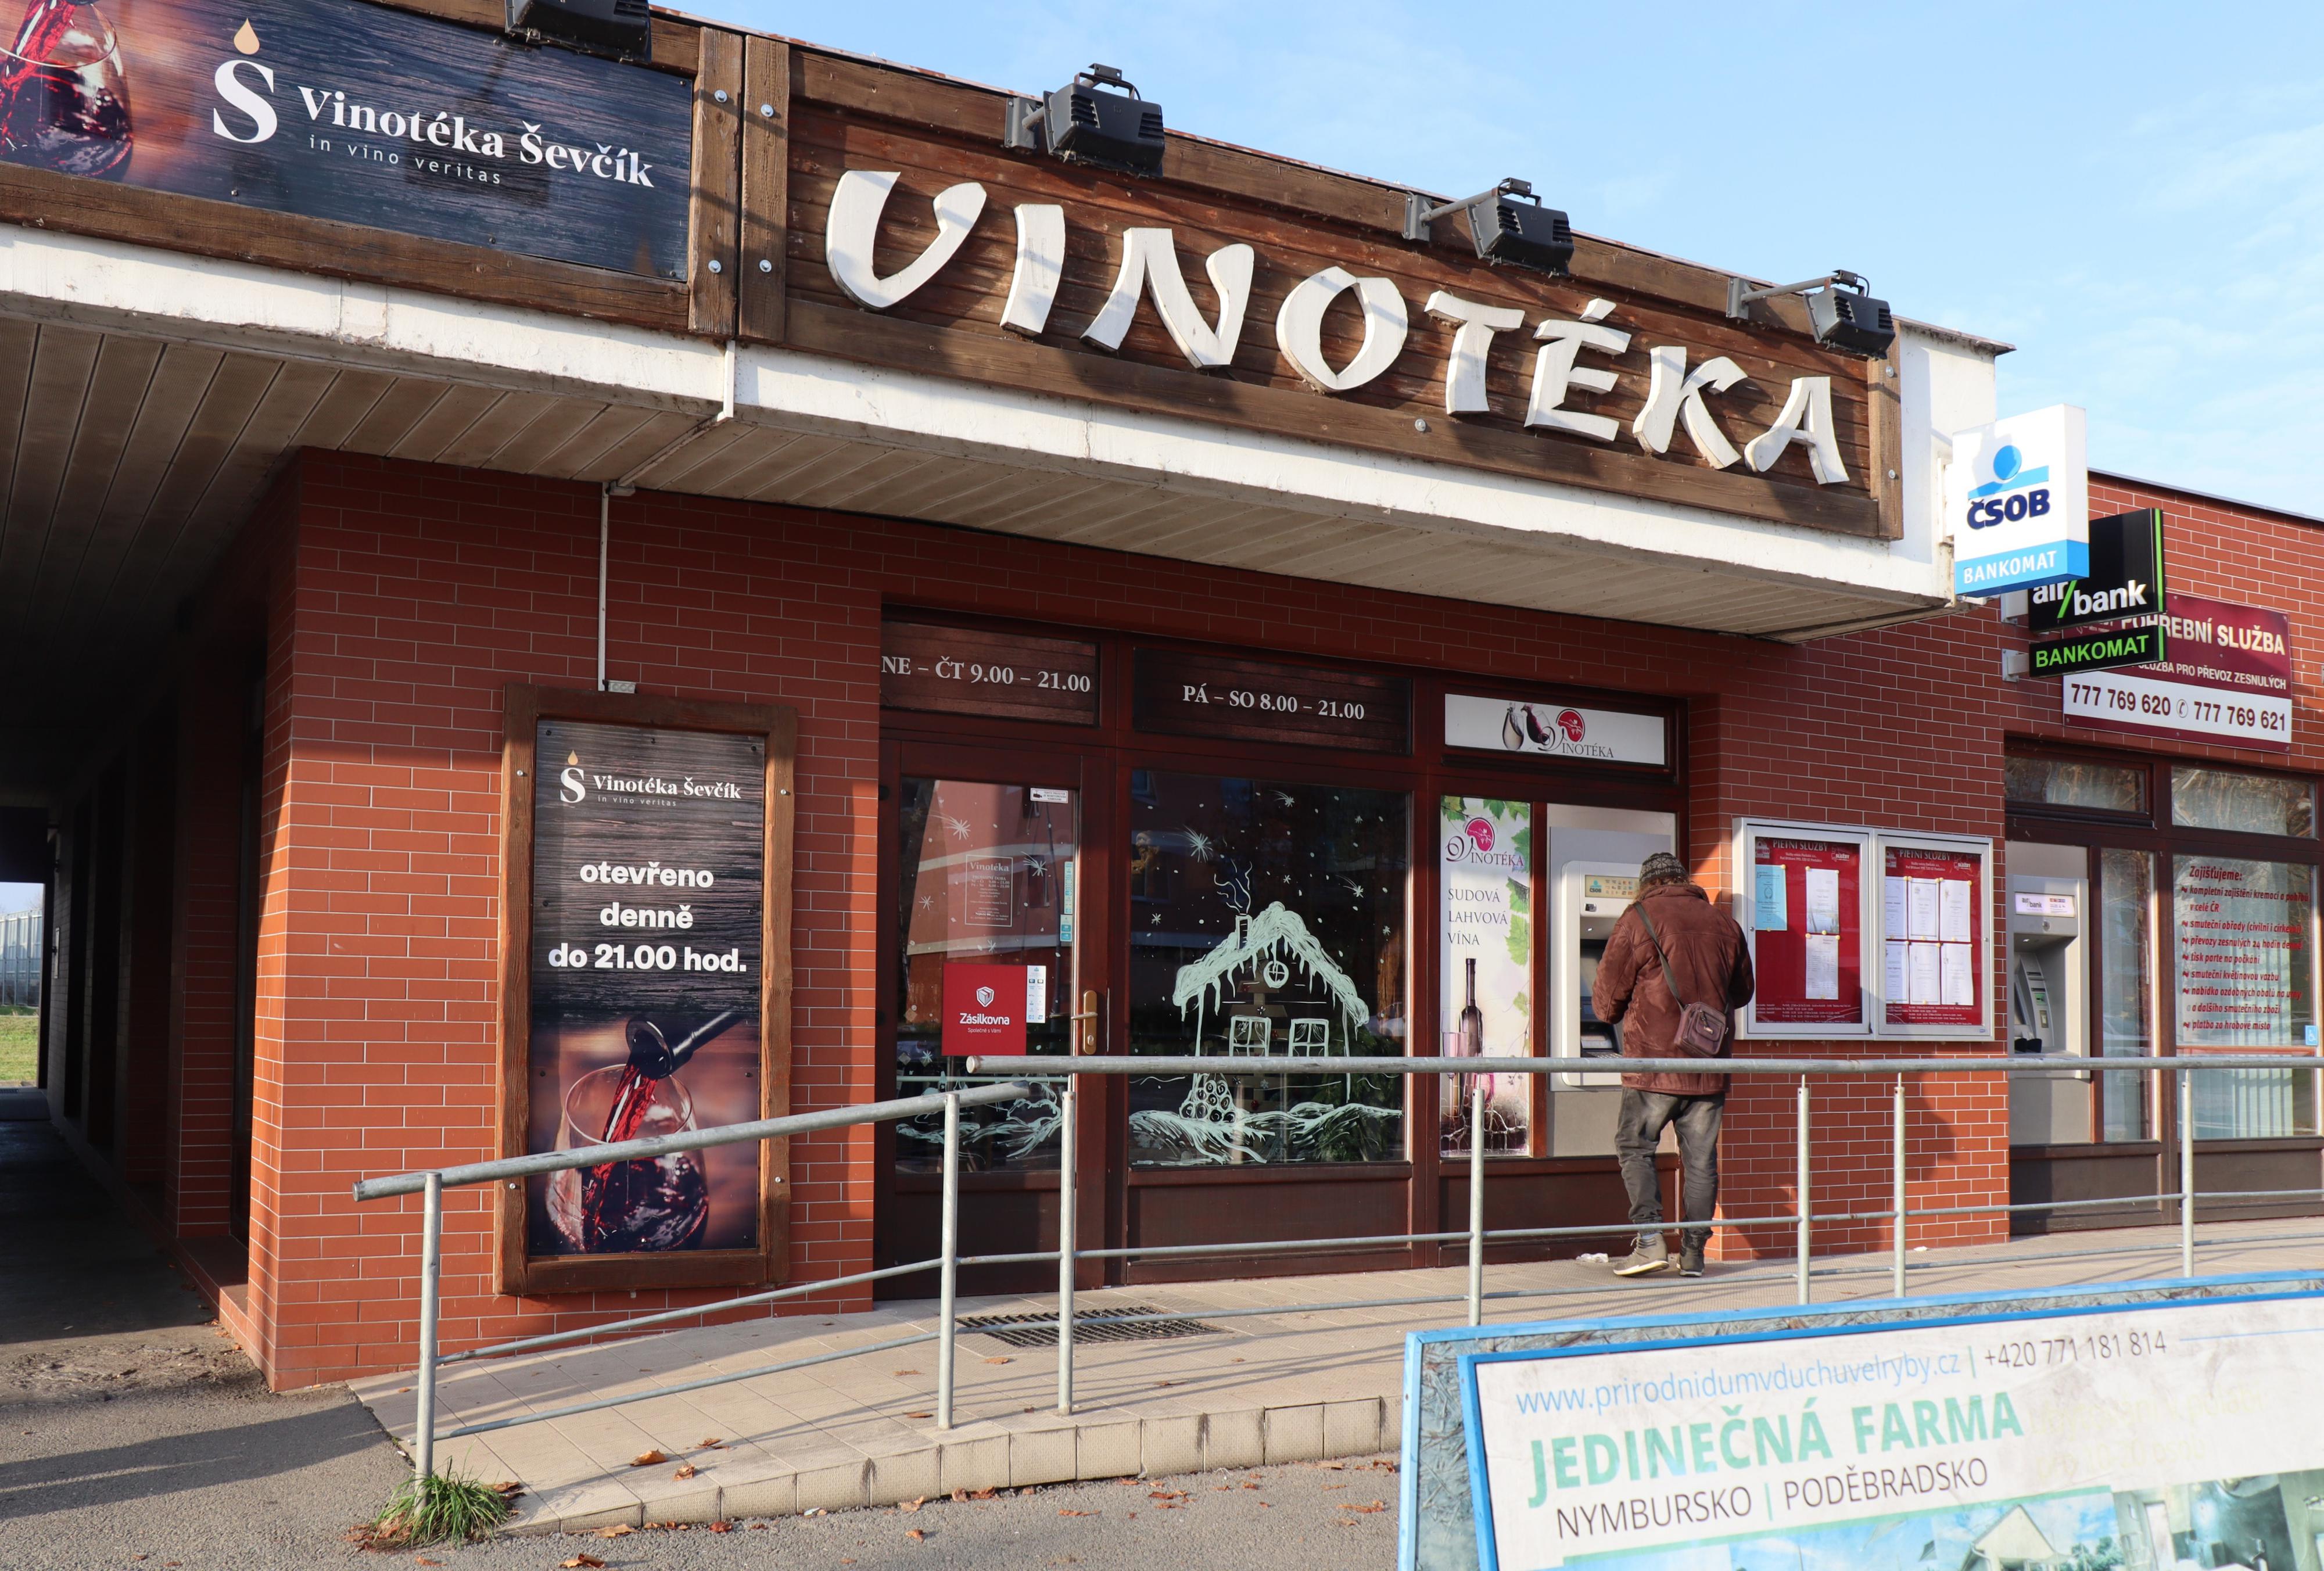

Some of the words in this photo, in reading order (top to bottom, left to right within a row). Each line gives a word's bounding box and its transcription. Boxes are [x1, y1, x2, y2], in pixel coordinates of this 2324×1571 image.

[297, 86, 505, 159] Vinotéka
[520, 120, 654, 188] Ševčík
[309, 134, 331, 152] in
[348, 144, 399, 165] vino
[415, 156, 501, 185] veritas
[825, 169, 1850, 485] VINOTÉKA
[1967, 488, 2050, 530] ČSOB
[1964, 550, 2057, 584] BANKOMAT
[2036, 635, 2149, 668] BANKOMAT
[2217, 625, 2286, 656] SLUŽBA
[881, 655, 911, 676] NE
[935, 655, 964, 680] ČT
[970, 663, 1014, 684] 9.00
[1038, 670, 1091, 693] 21.00
[2176, 663, 2195, 677] PRO
[2197, 665, 2232, 682] PŘEVOZ
[2234, 670, 2286, 690] ZESNULÝCH
[1183, 683, 1209, 704] PÁ
[1229, 690, 1254, 708] SO
[1260, 694, 1298, 713] 8.00
[1317, 700, 1365, 720] 21.00
[2071, 683, 2101, 706] 777
[2107, 688, 2136, 711] 769
[2142, 694, 2171, 716] 620
[2193, 701, 2221, 723] 777
[2226, 705, 2255, 727] 769
[2261, 711, 2286, 731] 621
[593, 774, 677, 795] Vinotéka
[683, 777, 742, 799] Ševčík
[612, 796, 635, 805] vino
[640, 798, 677, 807] veritas
[580, 861, 714, 888] otevřeno
[970, 862, 1009, 871] Vinotéka
[2189, 866, 2243, 882] Zajišťujeme:
[1448, 888, 1501, 902] SUDOVÁ
[2190, 885, 2223, 897] kompletní
[2224, 888, 2252, 899] zajištění
[2254, 889, 2279, 899] kremací
[600, 902, 694, 929] denně
[1448, 910, 1508, 925] LAHVOVÁ
[2195, 902, 2208, 911] celé
[2210, 901, 2219, 912] ČR
[1447, 930, 1480, 945] VÍNA
[2190, 919, 2221, 930] smuteční
[2222, 921, 2245, 932] obřady
[2190, 936, 2217, 948] převozy
[2218, 937, 2250, 949] zesnulých
[2253, 941, 2261, 950] 24
[2262, 939, 2280, 949] hodin
[548, 942, 587, 968] do
[594, 944, 677, 970] 21.00
[683, 946, 747, 972] hod.
[2191, 952, 2203, 962] tisk
[2205, 954, 2222, 964] parte
[2234, 953, 2261, 965] počkání
[2192, 969, 2222, 980] smuteční
[2223, 970, 2258, 980] květinovou
[2260, 971, 2279, 981] vazbu
[2192, 985, 2218, 995] nabídka
[2220, 987, 2255, 999] ozdobných
[2257, 987, 2275, 997] obalů
[959, 1013, 1010, 1025] Zásilkovna
[2198, 1002, 2222, 1012] dalšího
[2224, 1003, 2262, 1013] smutečního
[2264, 1005, 2280, 1014] zboží
[2193, 1020, 2214, 1030] platba
[2225, 1020, 2251, 1030] hrobové
[2253, 1021, 2270, 1030] místo
[1517, 1350, 1960, 1415] www.prirodnidumvduchuvelryby.cz
[1984, 1342, 2037, 1368] +420
[2041, 1337, 2079, 1365] 771
[2087, 1334, 2122, 1360] 181
[2131, 1330, 2167, 1356] 814
[1528, 1397, 1833, 1508] JEDINEČNÁ
[1851, 1392, 2024, 1454] FARMA
[1556, 1486, 1753, 1540] NYMBURSKO
[1785, 1457, 1988, 1511] PODĚBRADSKO
